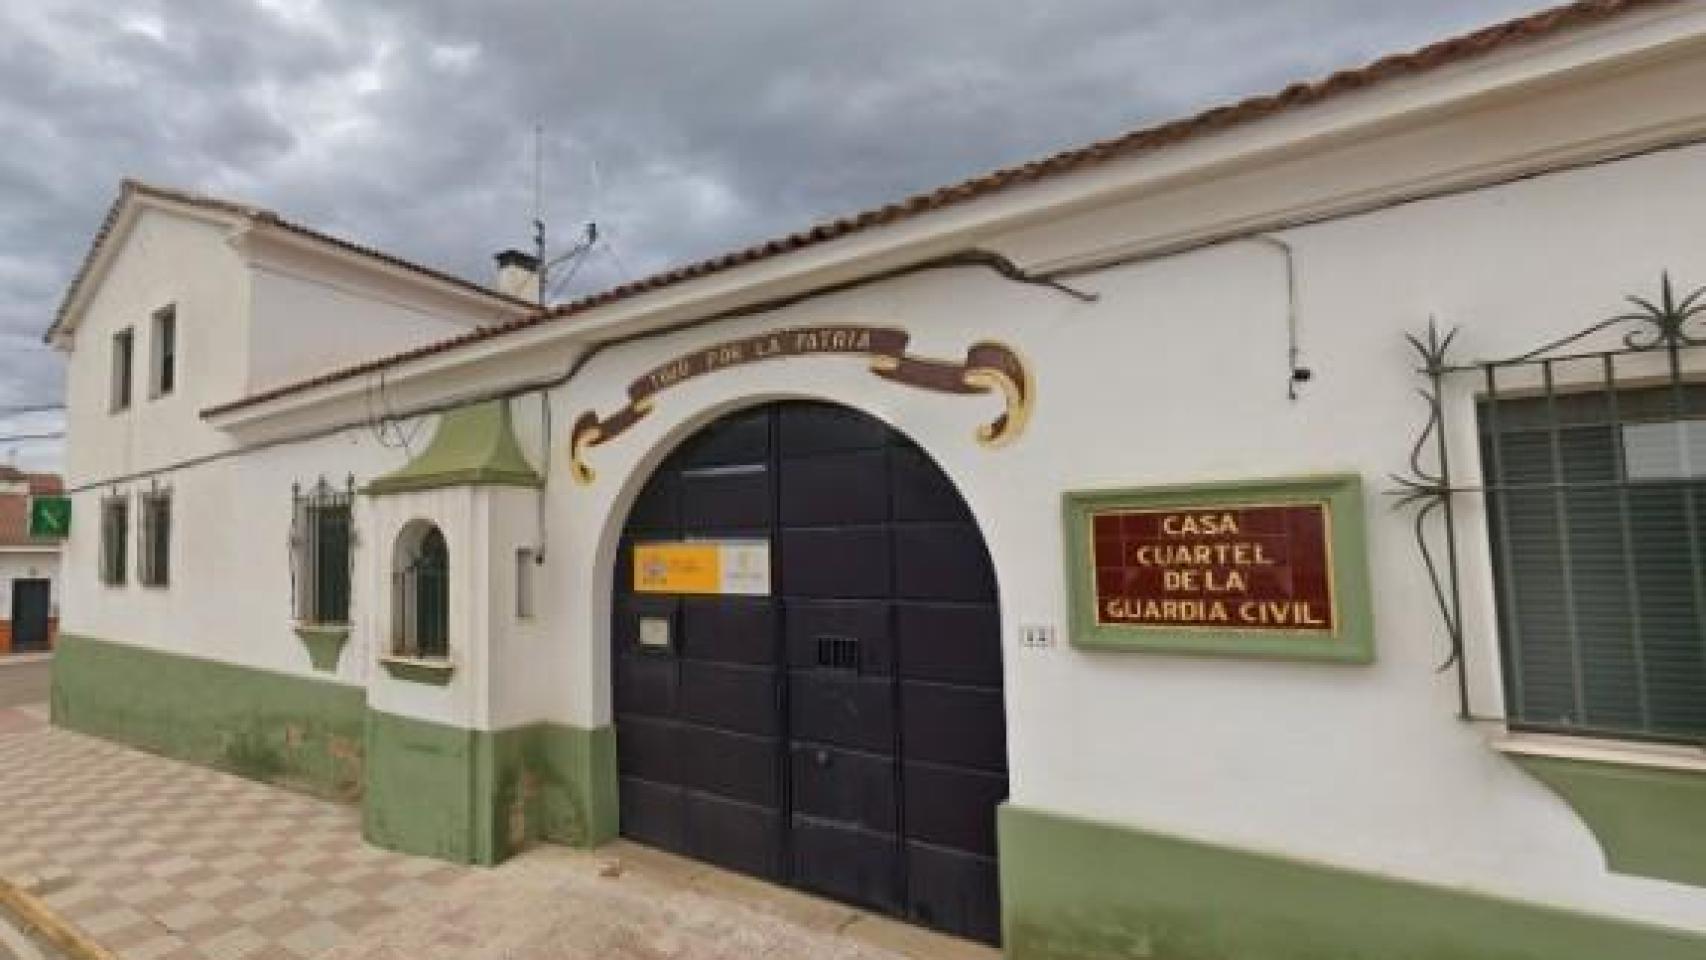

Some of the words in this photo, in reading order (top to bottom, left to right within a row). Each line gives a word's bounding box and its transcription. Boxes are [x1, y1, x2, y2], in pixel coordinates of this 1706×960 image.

[797, 328, 871, 352] PATRIA
[1163, 513, 1240, 535] CASA
[1136, 544, 1275, 565] CUARTEL
[1163, 569, 1198, 590] DE
[1205, 569, 1246, 590] LA
[1106, 600, 1228, 621] GUARDIA
[1238, 601, 1325, 624] CIVIL
